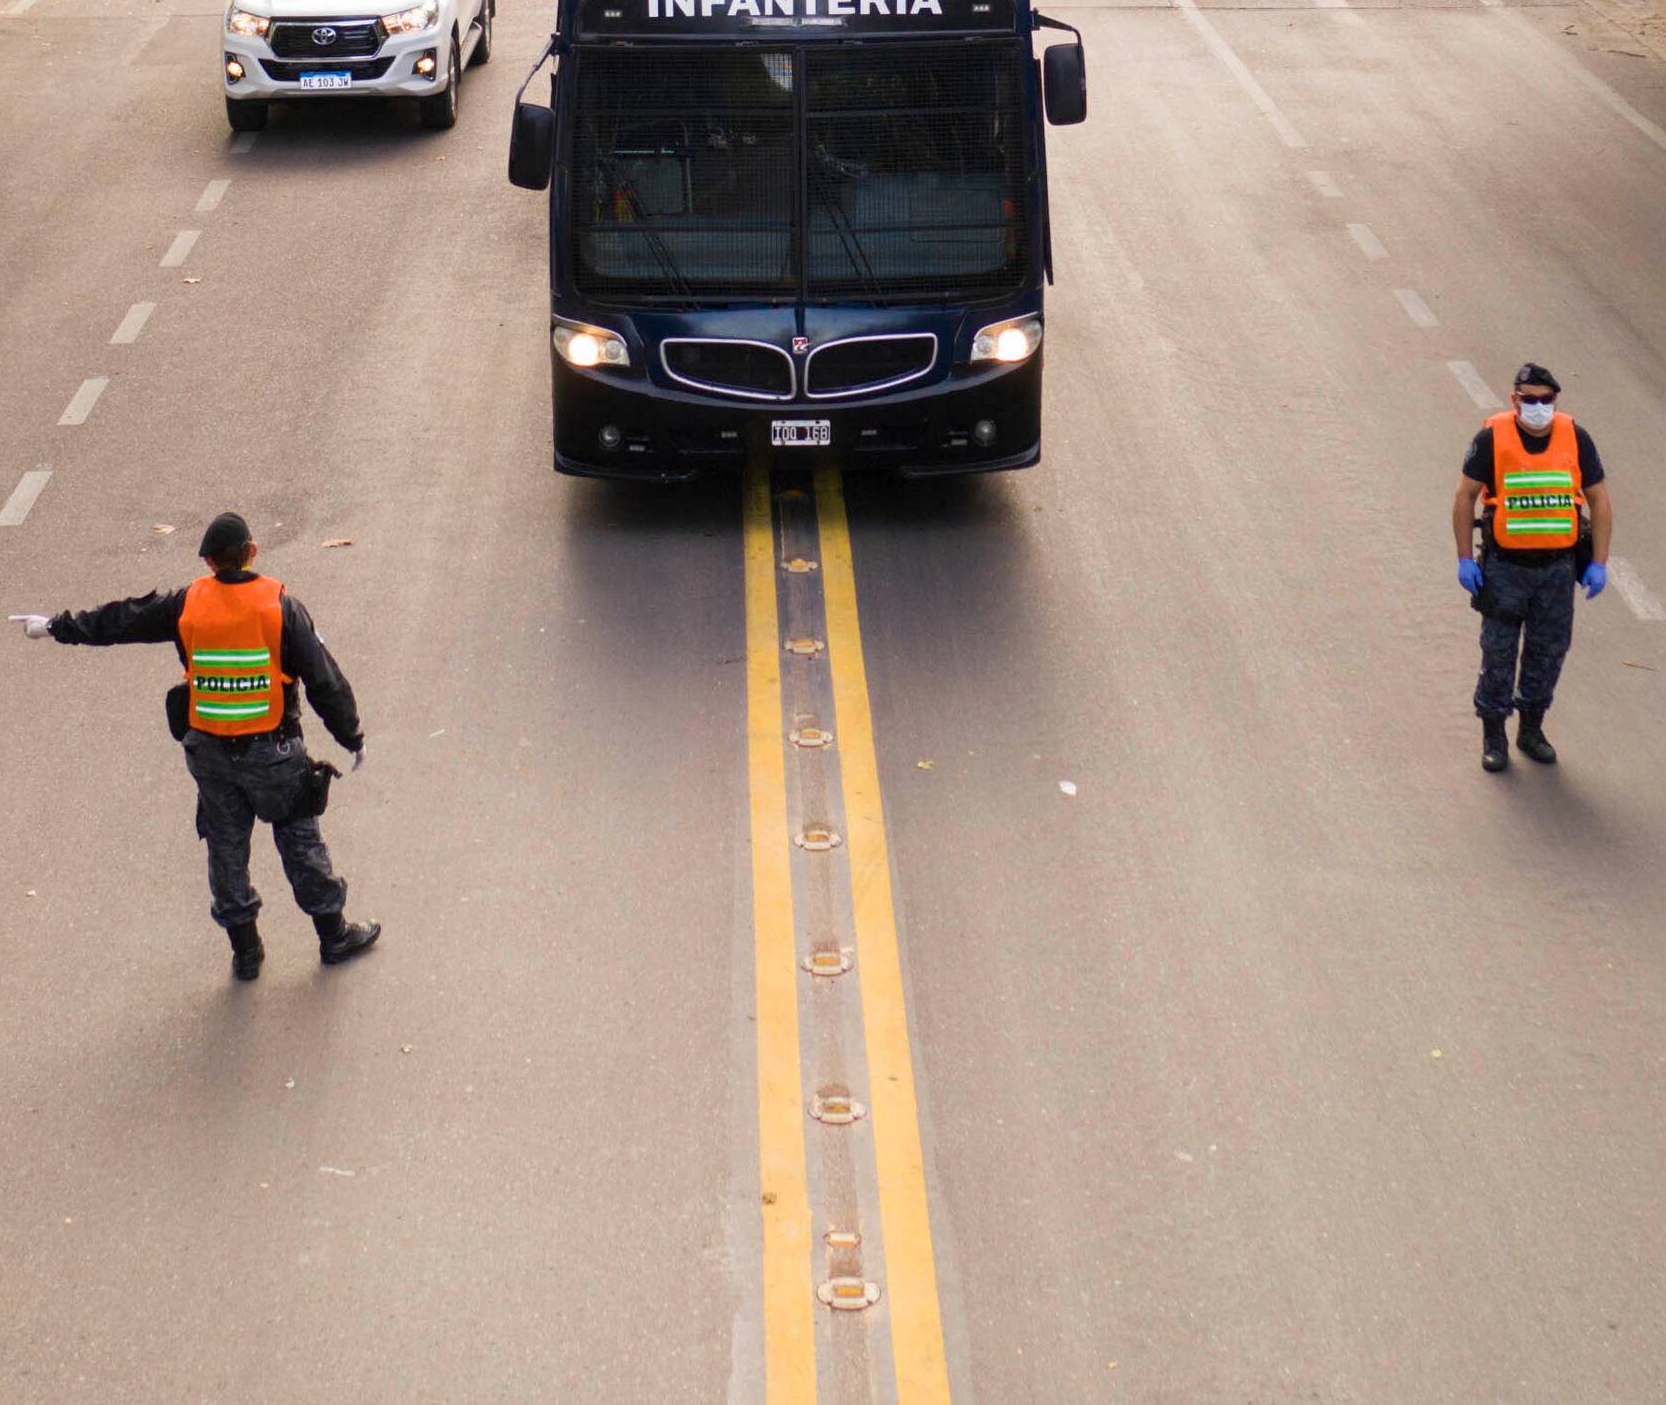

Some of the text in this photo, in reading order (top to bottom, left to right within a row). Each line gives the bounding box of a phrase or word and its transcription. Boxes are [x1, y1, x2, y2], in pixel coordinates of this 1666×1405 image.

[303, 79, 314, 87] AE
[317, 77, 335, 87] 103
[804, 426, 829, 441] 168
[1507, 494, 1572, 510] POLICIA
[196, 675, 269, 692] POLICIA
